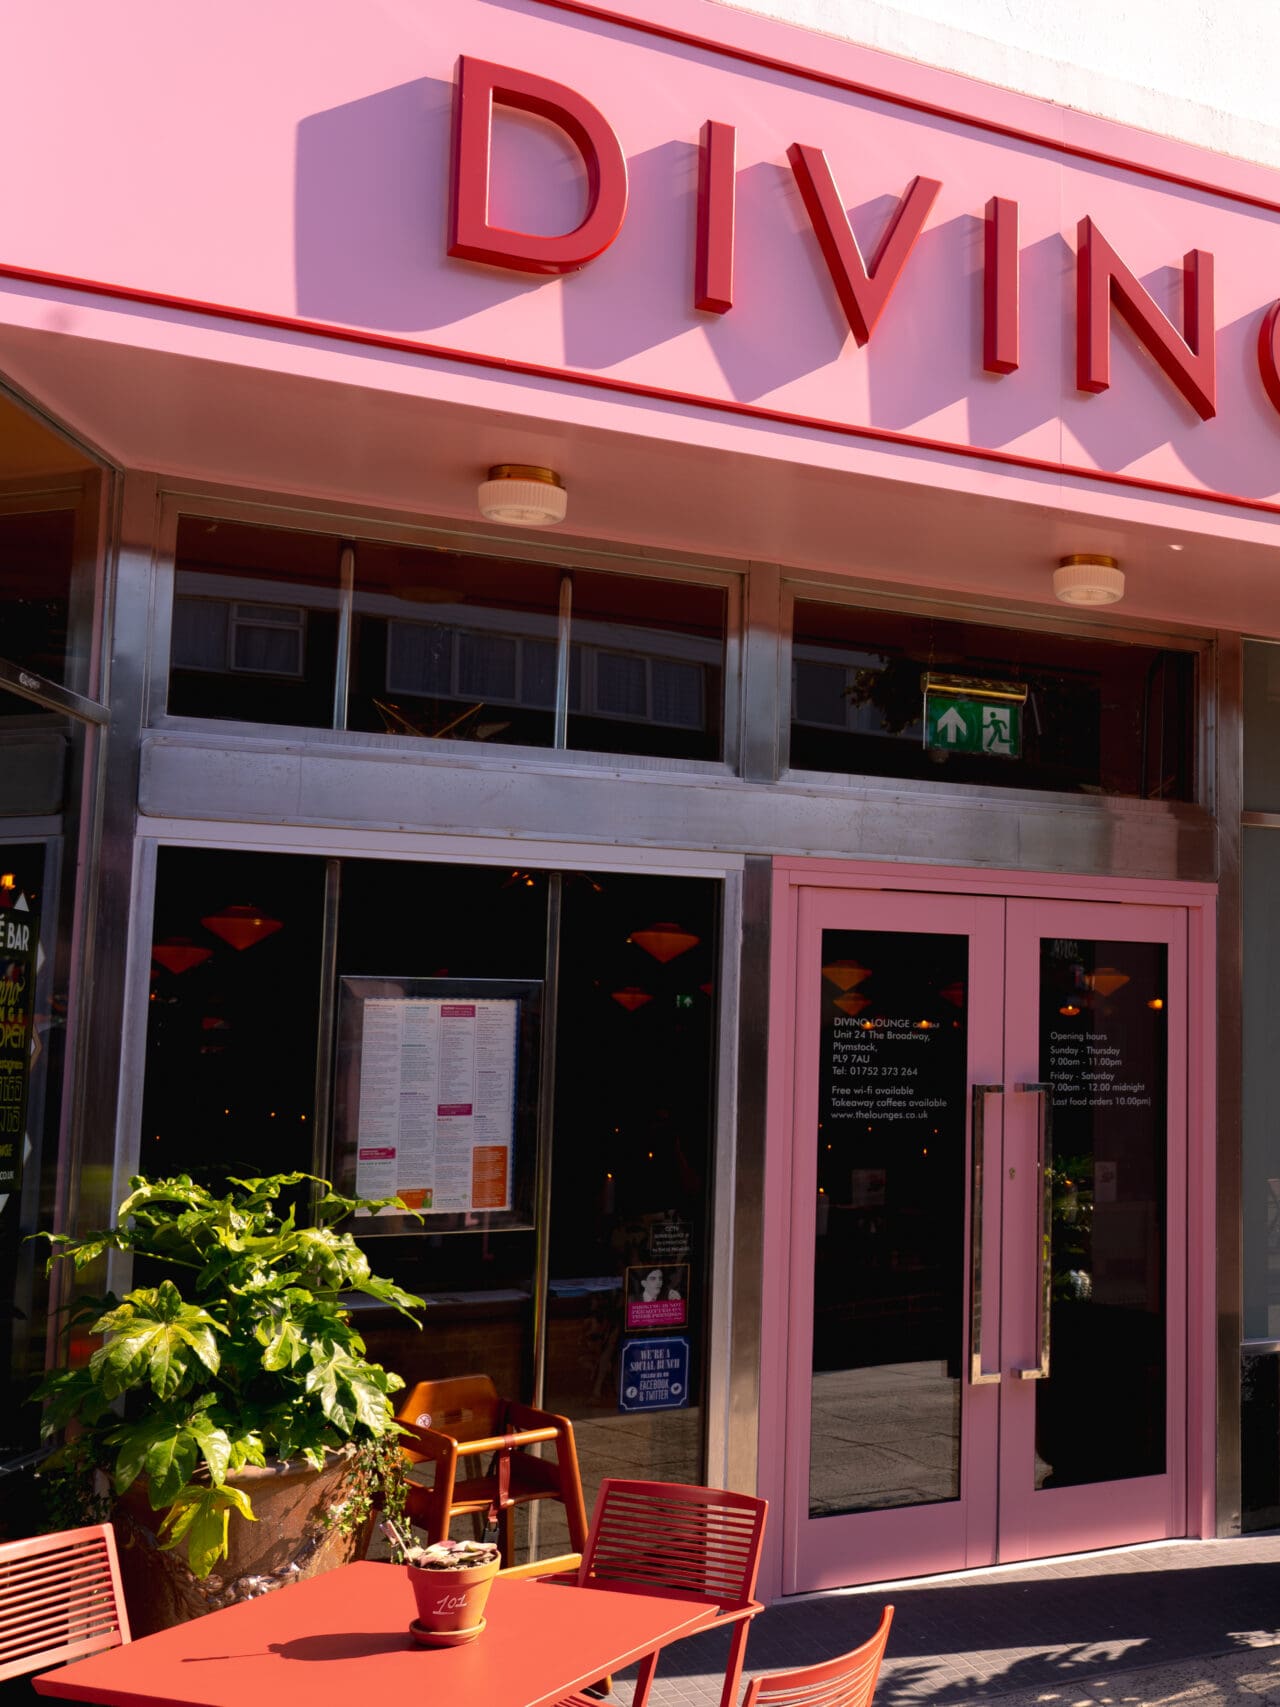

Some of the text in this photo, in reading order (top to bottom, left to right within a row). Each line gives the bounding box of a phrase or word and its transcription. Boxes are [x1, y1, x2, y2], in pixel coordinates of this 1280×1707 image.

[7, 922, 30, 951] BAR
[872, 1018, 910, 1028] LOUNGE
[833, 1029, 930, 1044] Unit 24 The Broadway,
[1050, 1031, 1108, 1042] Opening hours
[833, 1041, 878, 1053] Plymstock,
[1050, 1045, 1079, 1056] Sunday
[1087, 1046, 1121, 1056] Thursday
[832, 1054, 870, 1063] PL9 7AU
[1050, 1057, 1080, 1066] 9.00am
[1088, 1058, 1122, 1067] 11.00pm
[832, 1066, 918, 1076] Tel: 01752 373 264
[1050, 1071, 1074, 1082] Friday
[1081, 1071, 1115, 1082] Saturday
[832, 1085, 914, 1095] Free wi-fi available
[1088, 1083, 1111, 1092] 12.00
[1112, 1083, 1145, 1094] midnight
[832, 1097, 947, 1108] Takeaway coffees available
[1069, 1096, 1087, 1106] food
[1088, 1096, 1113, 1106] orders
[830, 1110, 928, 1121] www.thelounges.co.uk
[630, 1358, 680, 1371] SOCIAL BUNCH
[640, 1379, 669, 1390] FACEBOOK
[646, 1389, 669, 1400] TWITTER
